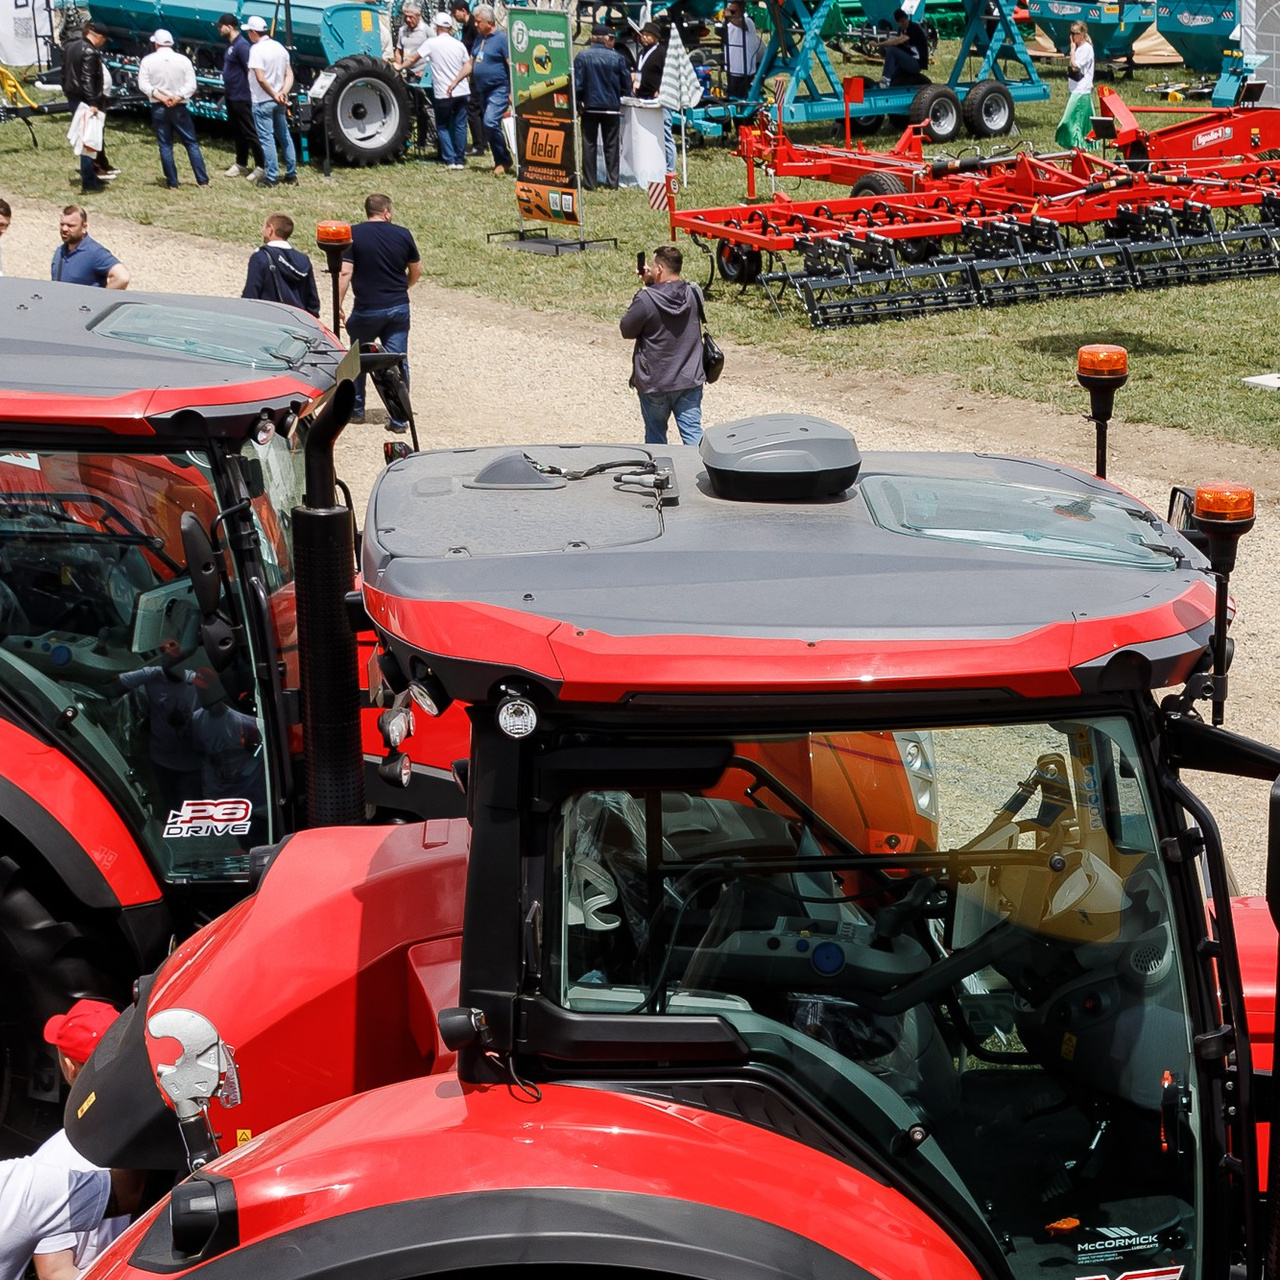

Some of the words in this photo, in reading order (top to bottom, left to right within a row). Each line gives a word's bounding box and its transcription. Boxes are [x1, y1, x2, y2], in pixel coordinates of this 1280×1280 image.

[531, 132, 559, 159] Belar
[164, 821, 251, 838] DRIVE
[1077, 1234, 1158, 1252] McCORMICK
